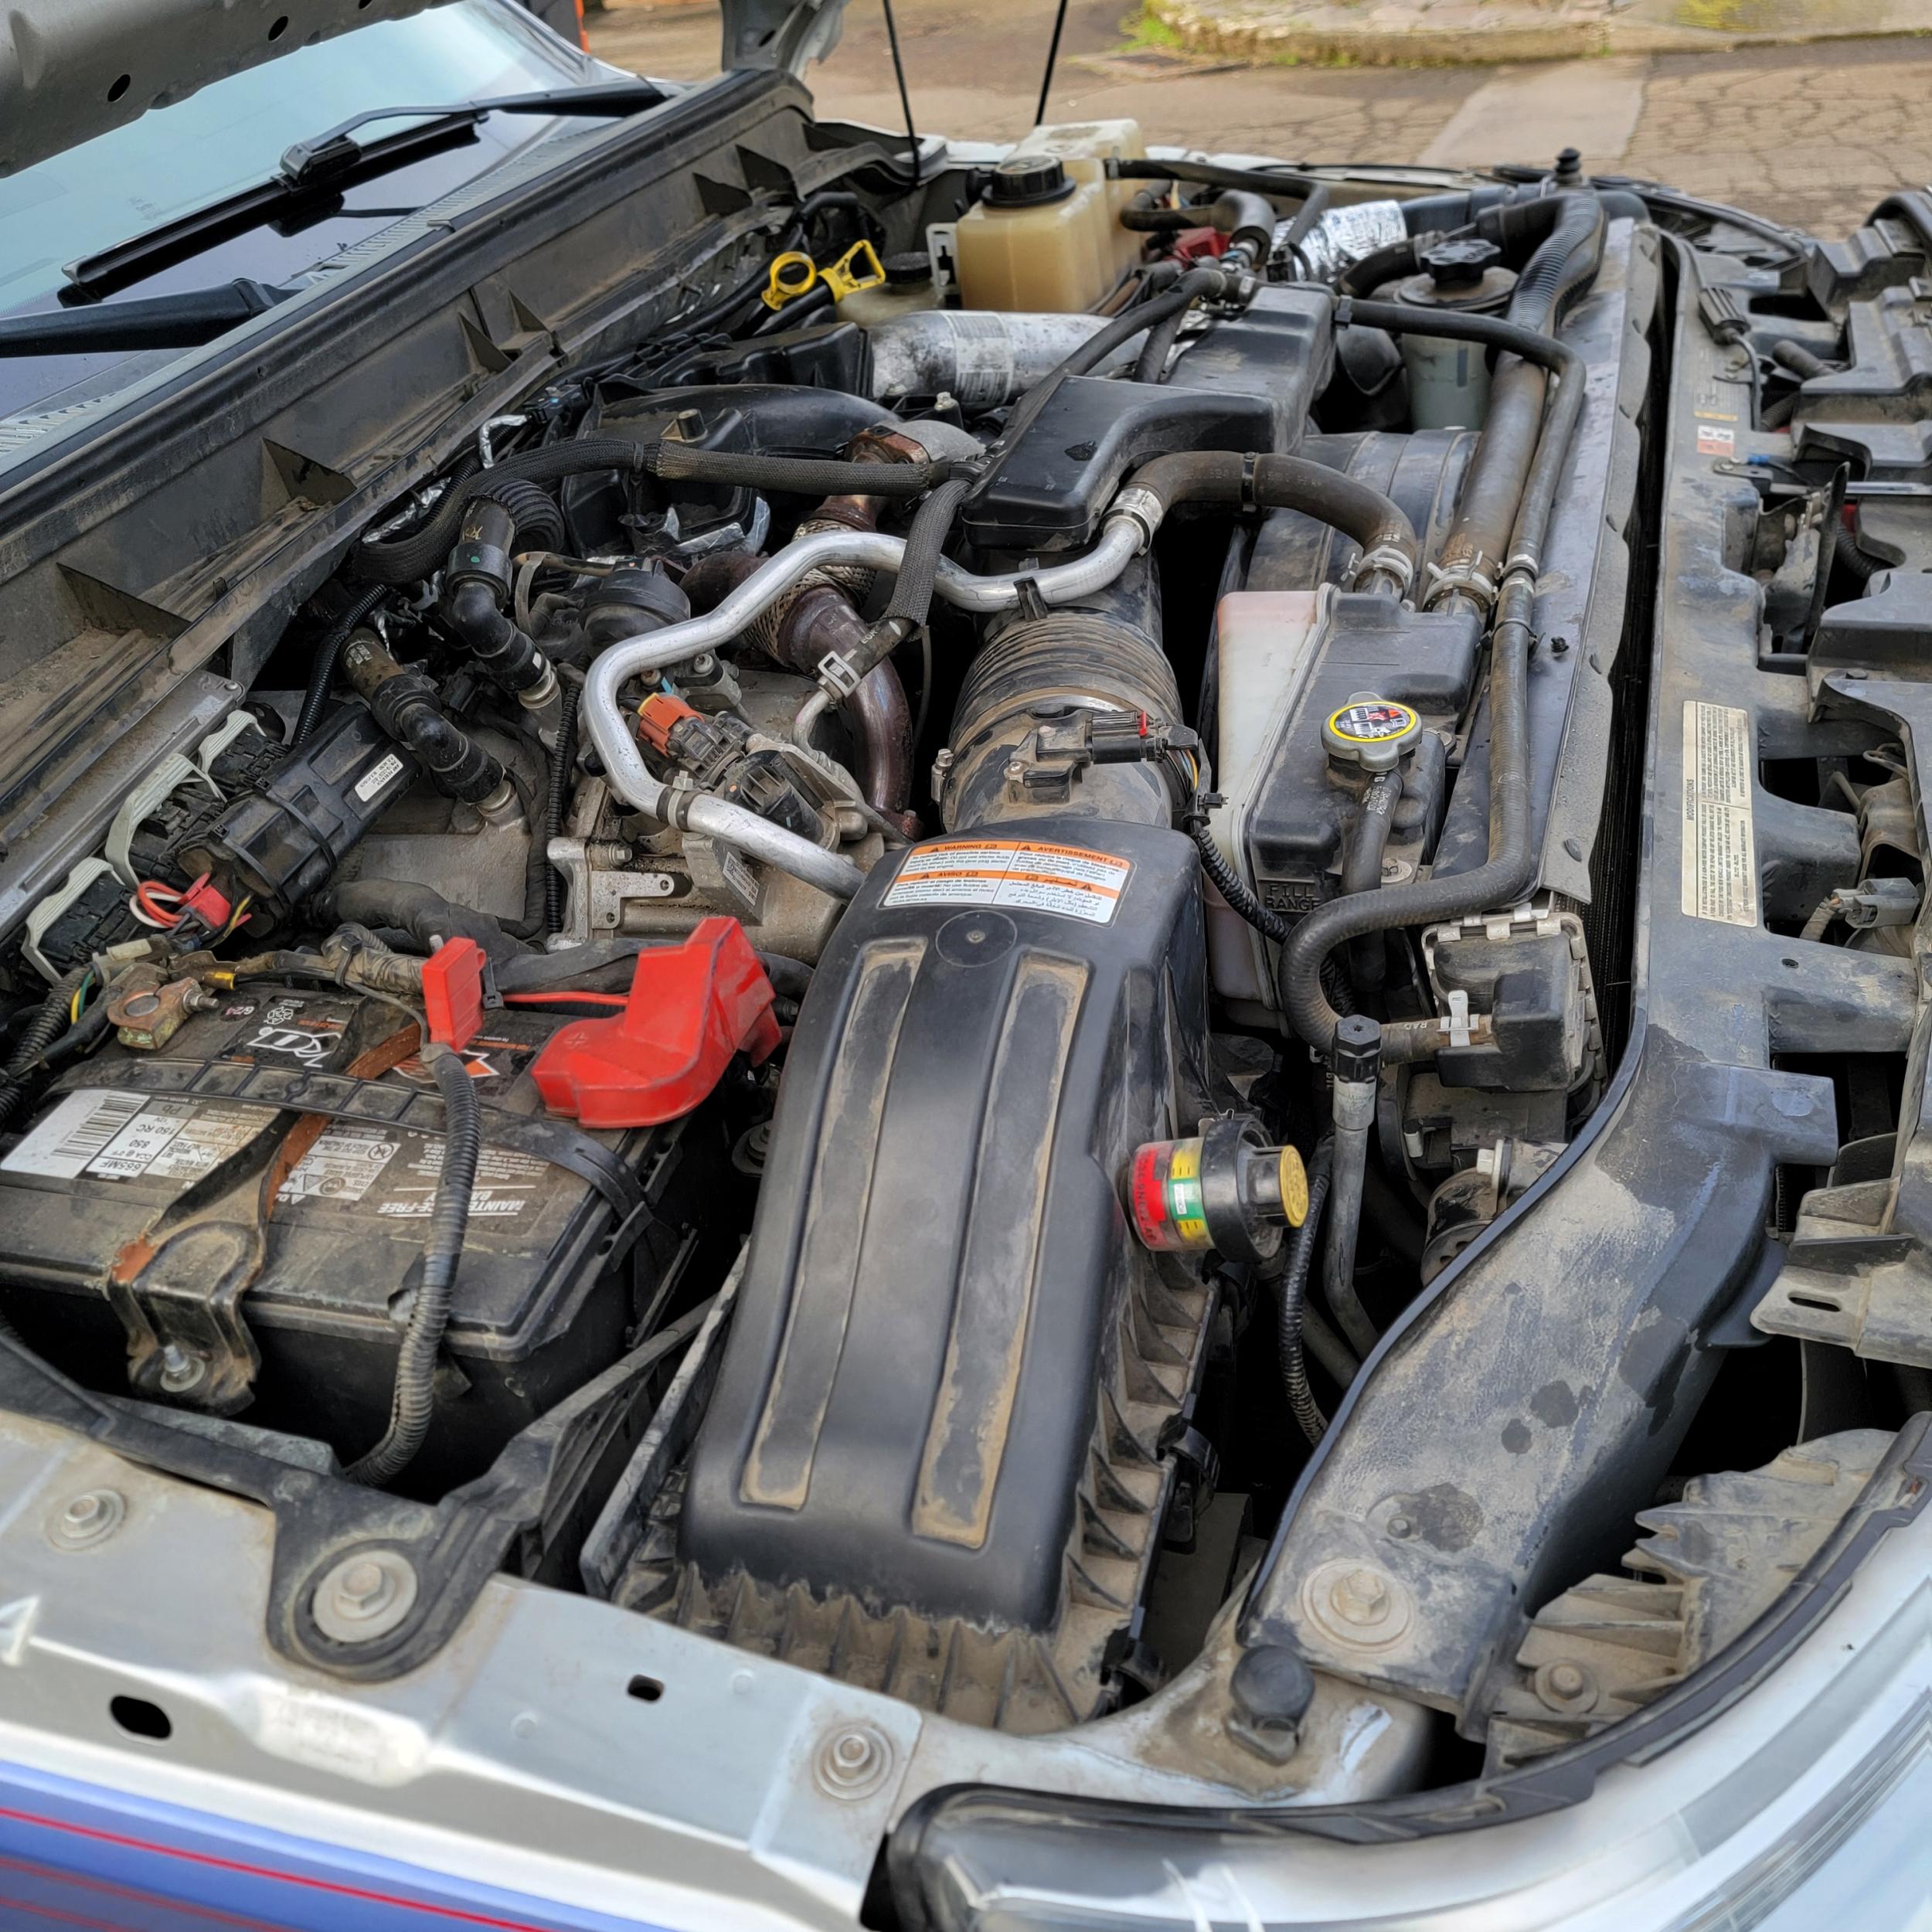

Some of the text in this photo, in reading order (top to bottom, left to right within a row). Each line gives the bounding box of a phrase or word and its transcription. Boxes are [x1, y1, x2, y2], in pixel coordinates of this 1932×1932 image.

[1686, 779, 1695, 821] MODIFICATIONS
[1038, 846, 1108, 862] AVERTISSEMENT
[1269, 883, 1314, 896] FILL
[1265, 896, 1321, 911] RANGE
[226, 1006, 254, 1015] 6/24
[162, 1104, 182, 1115] Pb
[136, 1124, 176, 1135] 150 RC
[128, 1139, 150, 1148] 850
[99, 1160, 141, 1172] 665MF
[377, 1200, 526, 1214] MAINTEE-FREE
